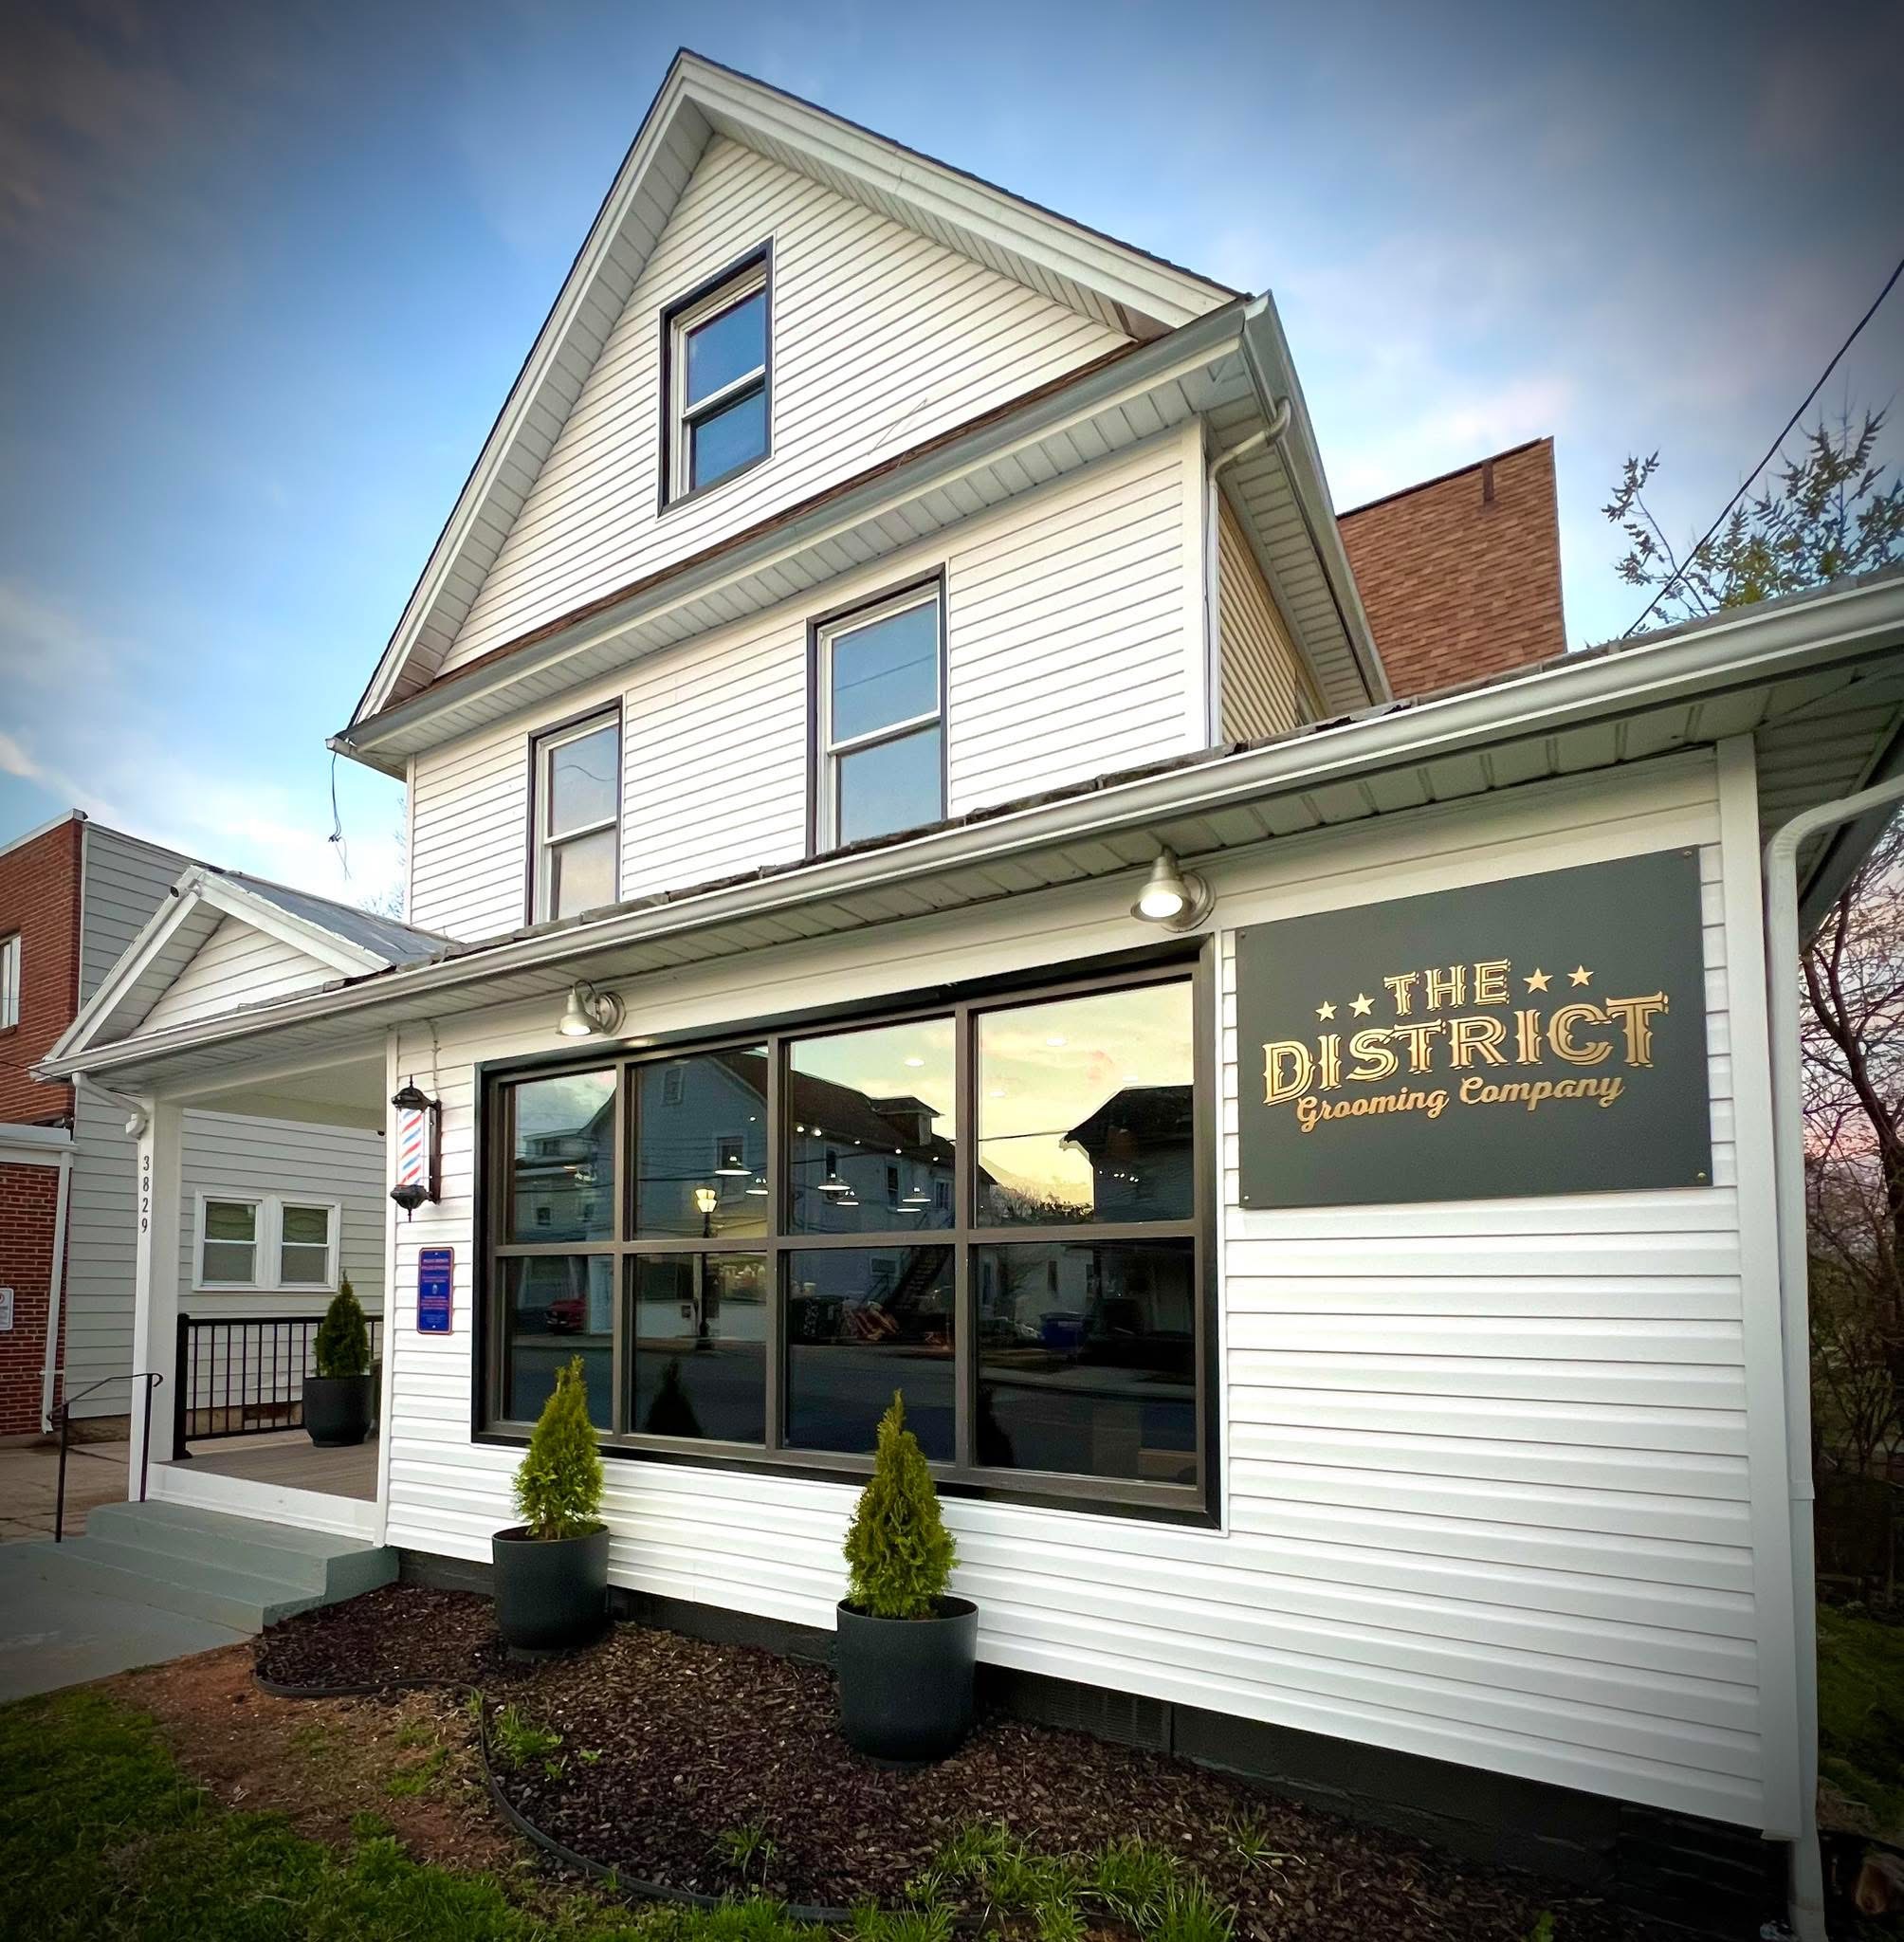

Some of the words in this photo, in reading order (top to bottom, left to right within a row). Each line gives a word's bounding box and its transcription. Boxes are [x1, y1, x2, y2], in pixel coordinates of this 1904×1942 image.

[1383, 958, 1511, 1016] THE
[1262, 990, 1670, 1106] DISTRICT
[1296, 1087, 1449, 1133] Grooming
[1459, 1073, 1625, 1110] Company
[141, 1155, 150, 1234] 3829
